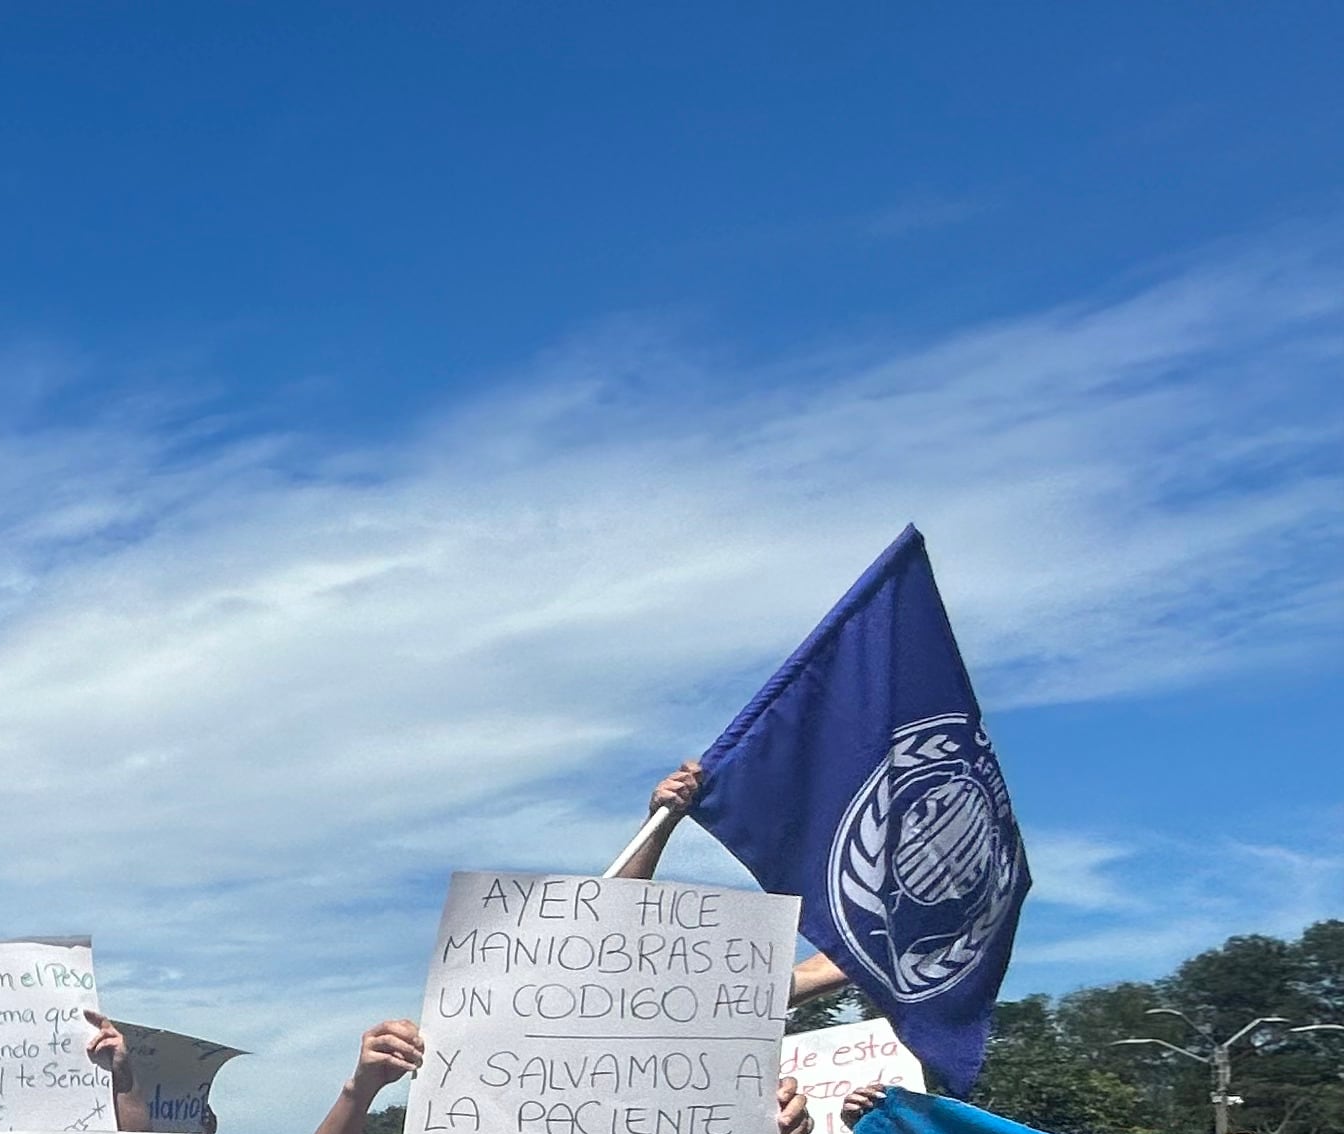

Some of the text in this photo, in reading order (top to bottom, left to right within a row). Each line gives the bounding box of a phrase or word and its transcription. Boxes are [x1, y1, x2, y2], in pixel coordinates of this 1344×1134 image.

[482, 879, 721, 930] AYER HICE
[443, 929, 774, 976] MANIOBRAS EN
[21, 963, 42, 988] el
[45, 1006, 80, 1032] que
[439, 984, 788, 1023] UN CODIGO AZUL
[48, 1032, 71, 1054] te
[780, 1034, 899, 1075] de esta
[16, 1067, 35, 1088] te
[437, 1049, 763, 1097] Y SALVAMOS A
[424, 1098, 479, 1132] LA
